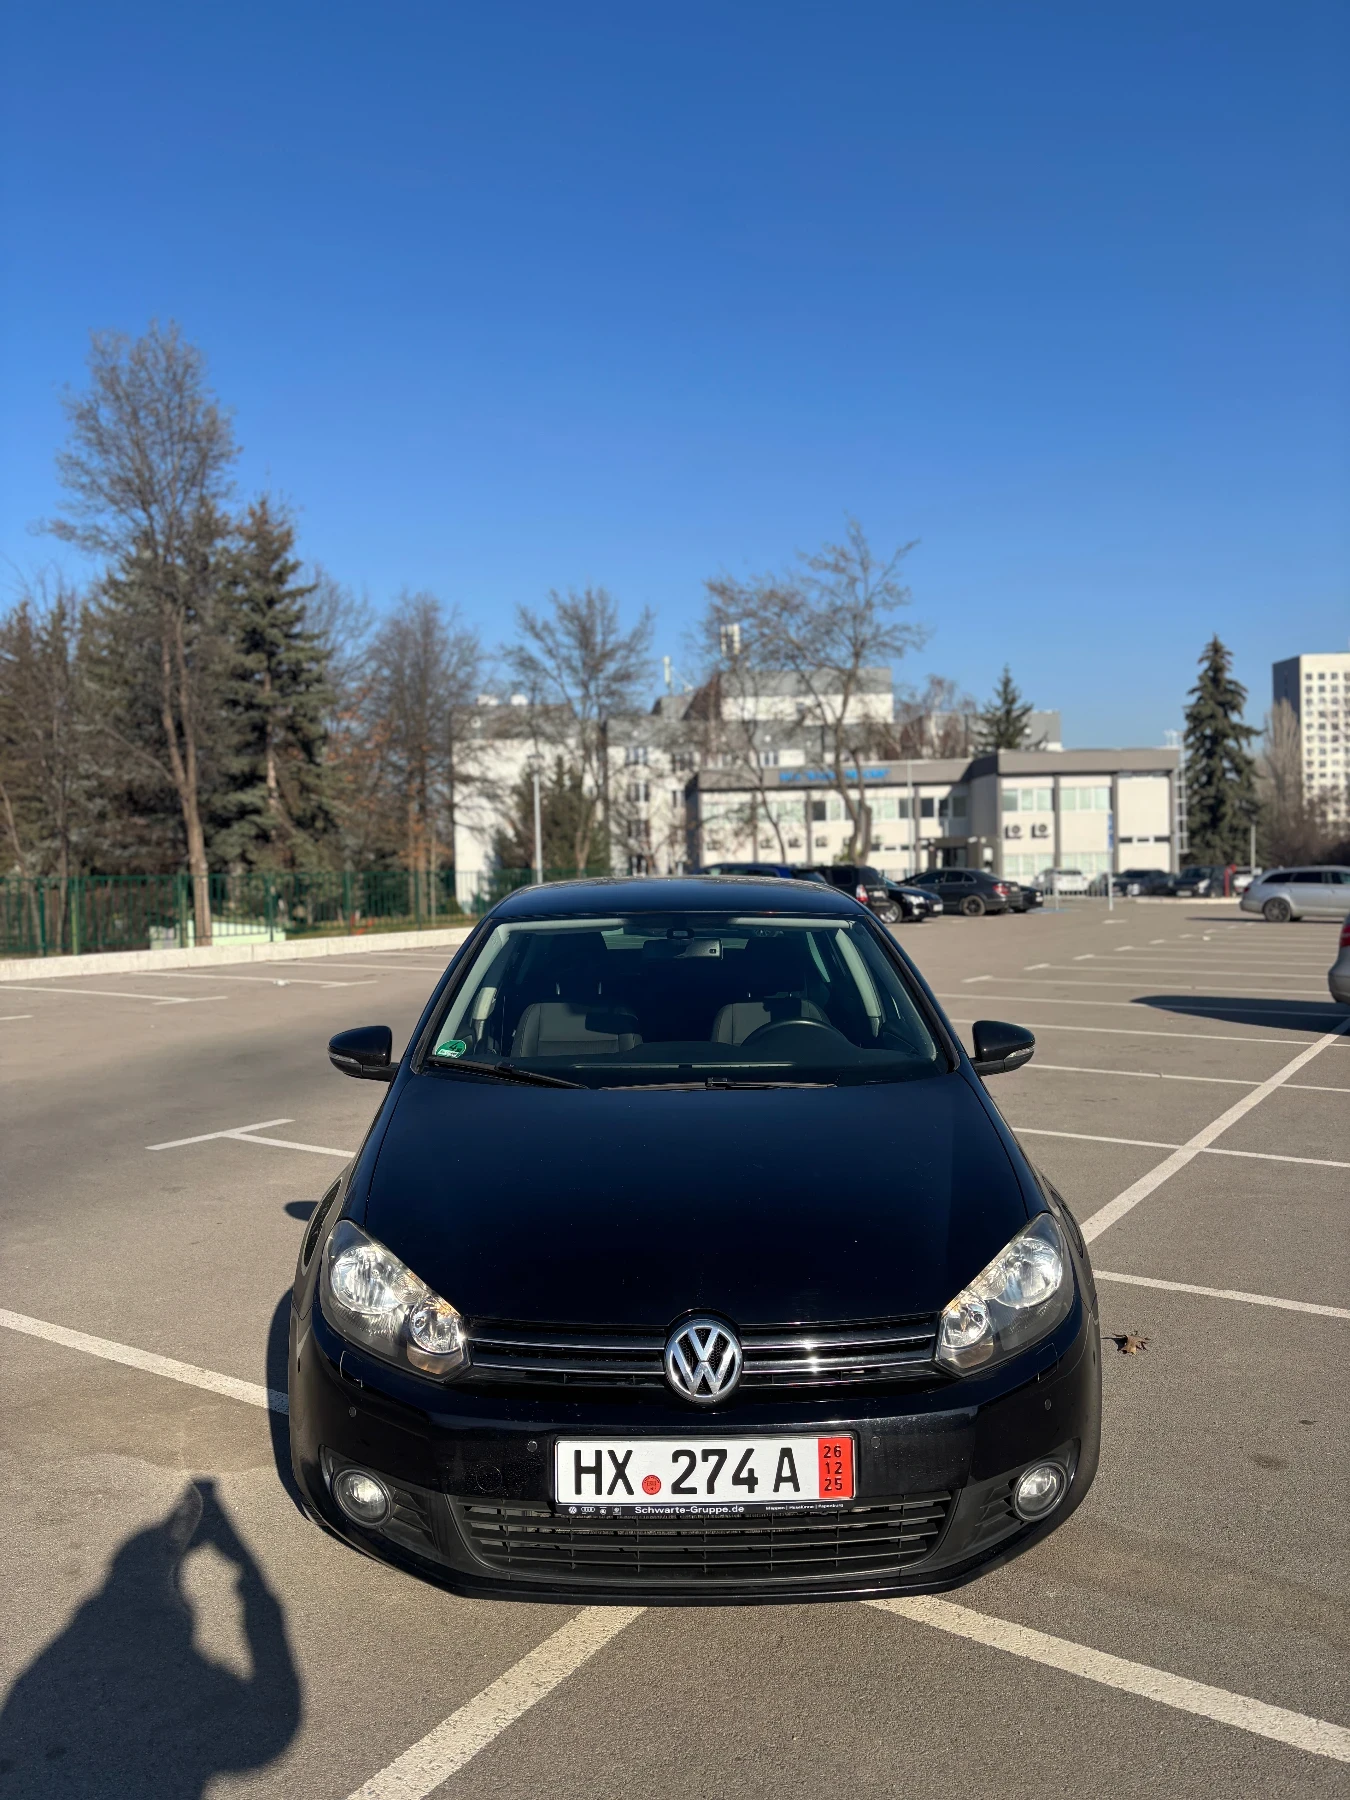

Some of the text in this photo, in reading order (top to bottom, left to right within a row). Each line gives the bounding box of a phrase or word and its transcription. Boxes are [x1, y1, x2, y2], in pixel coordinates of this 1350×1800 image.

[664, 1319, 742, 1402] VW
[823, 1445, 842, 1458] 26
[574, 1447, 801, 1496] HX 274 A
[825, 1461, 843, 1475] 12
[824, 1477, 843, 1491] 25
[634, 1505, 745, 1515] Schwarte-Gruppe.de
